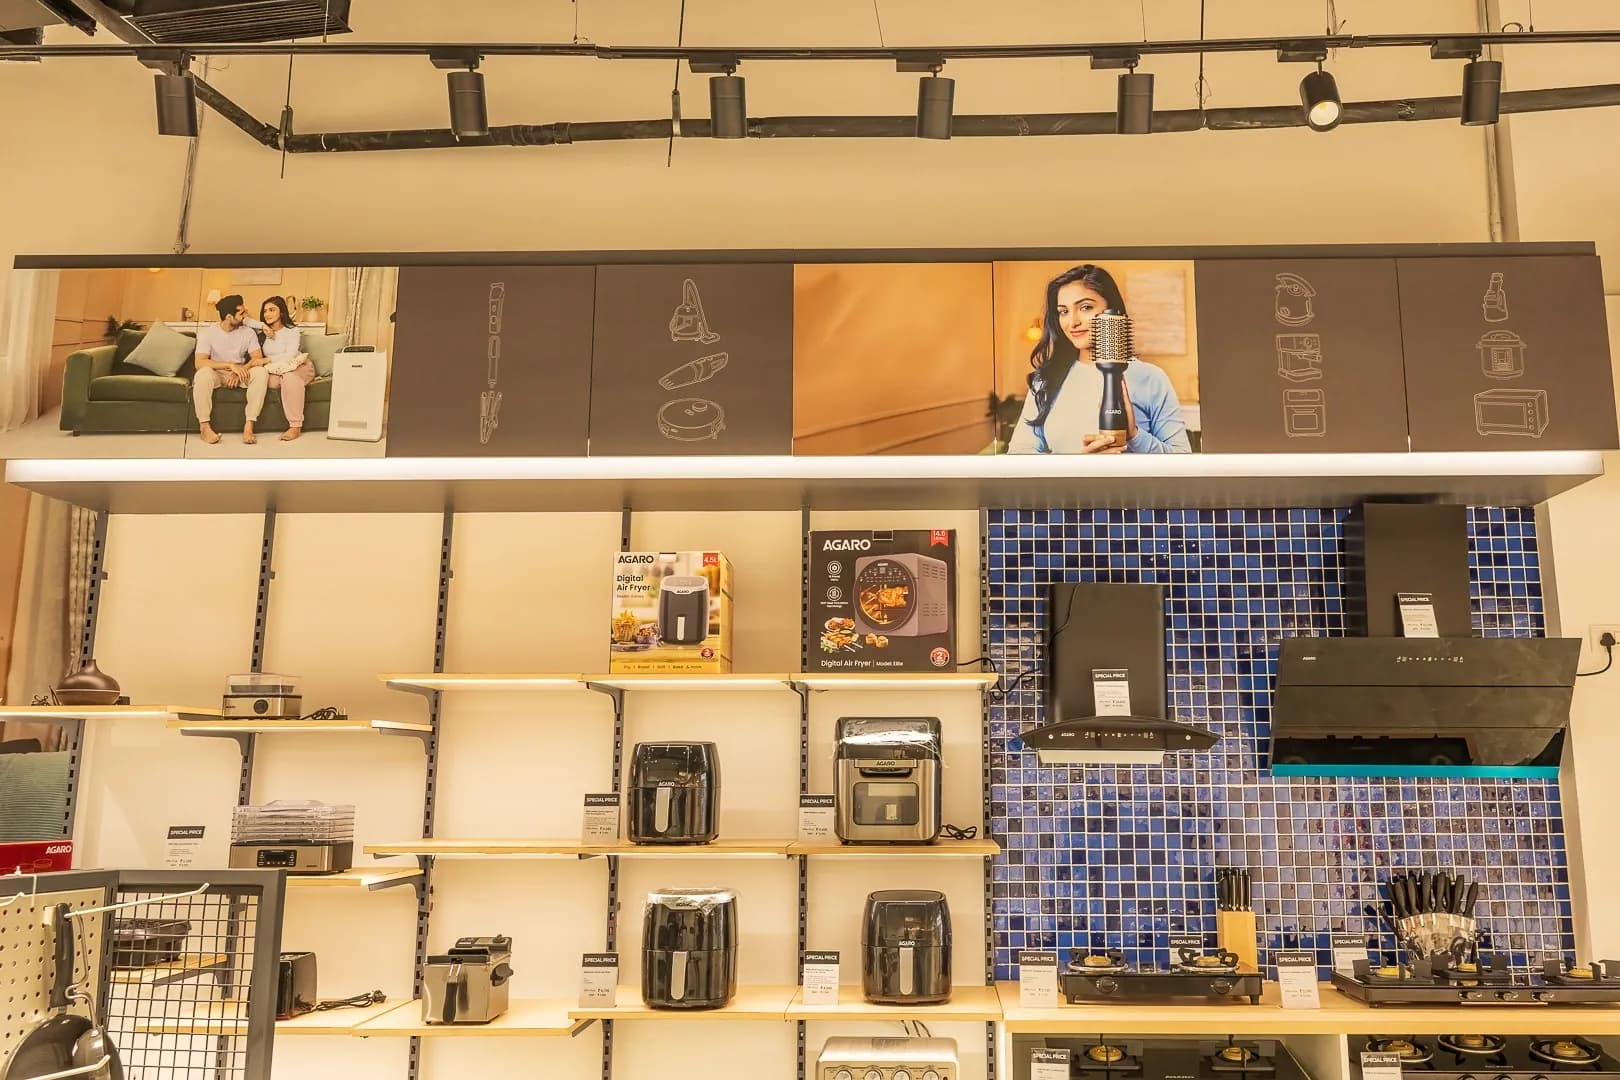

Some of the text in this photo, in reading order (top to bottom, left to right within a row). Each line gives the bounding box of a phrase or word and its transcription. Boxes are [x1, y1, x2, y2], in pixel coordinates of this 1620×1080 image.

[823, 539, 871, 551] AGARO
[618, 555, 654, 564] AGARO
[617, 575, 644, 583] Digital
[630, 584, 650, 592] Fryer
[821, 660, 842, 668] Digital
[855, 660, 871, 668] Fryer
[45, 845, 72, 855] AGARO
